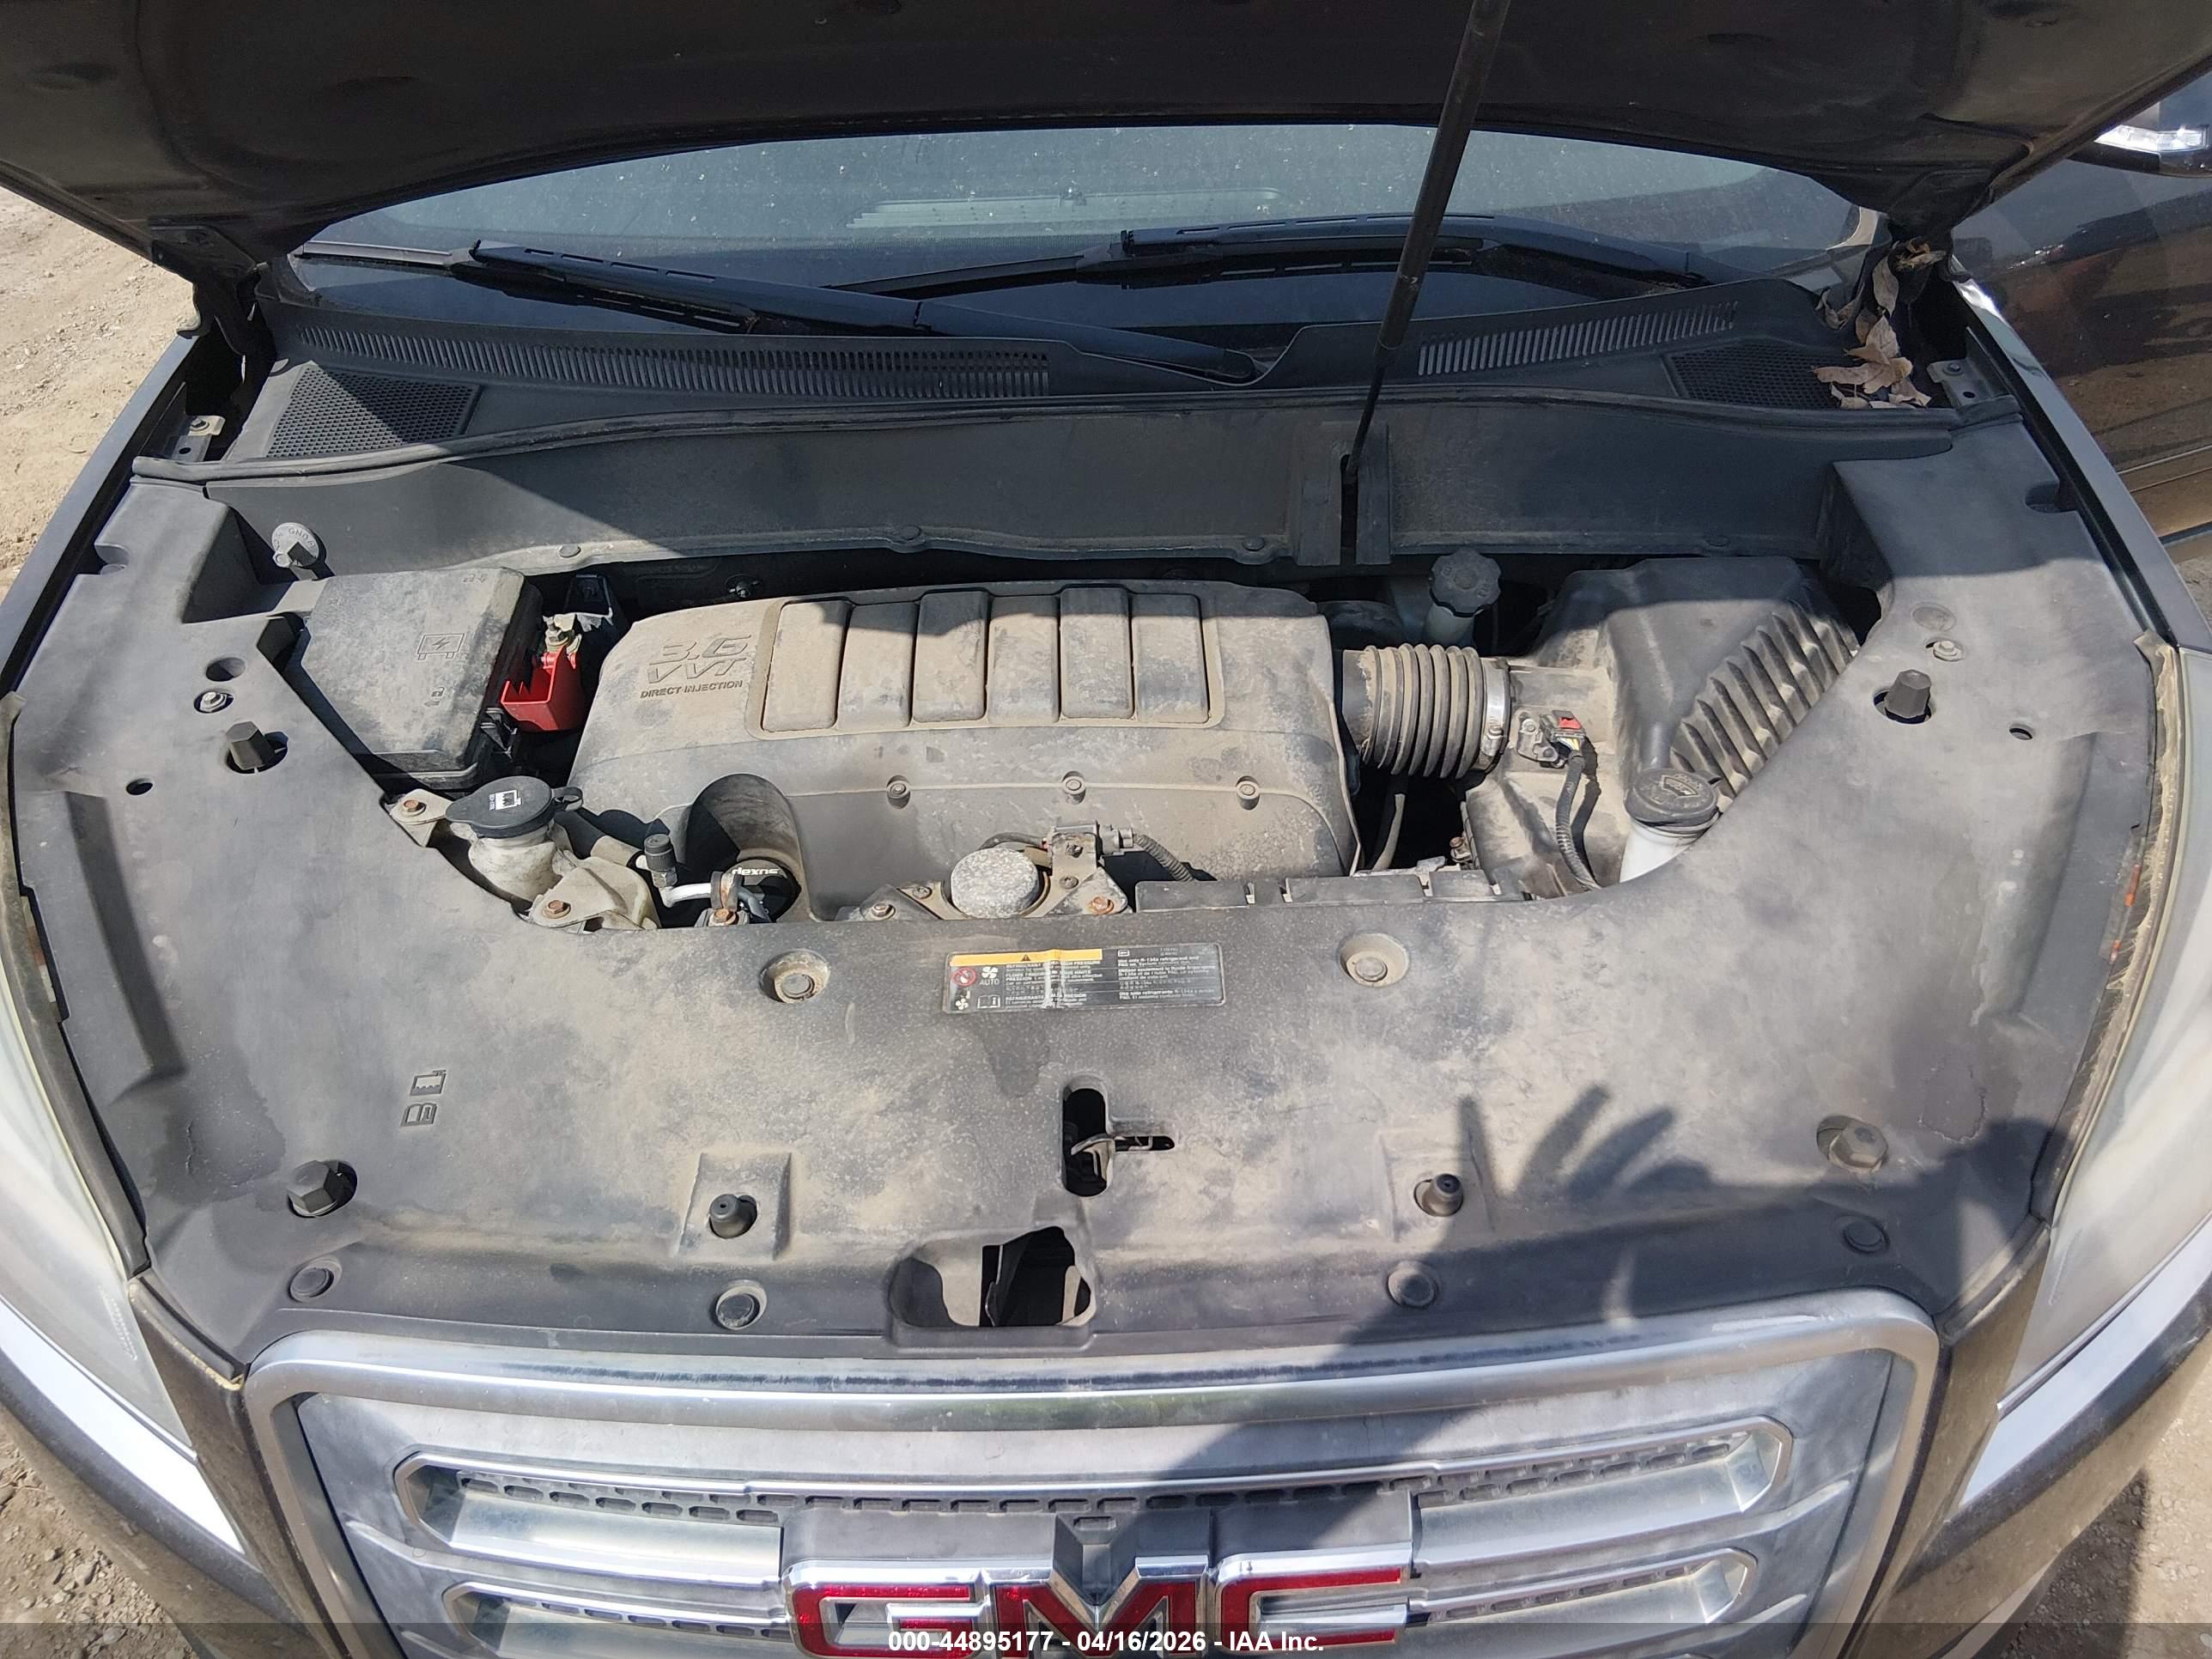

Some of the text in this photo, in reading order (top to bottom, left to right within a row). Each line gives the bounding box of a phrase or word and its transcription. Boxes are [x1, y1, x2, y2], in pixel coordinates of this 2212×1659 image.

[648, 634, 752, 666] 3.6
[647, 657, 747, 684] VVT
[640, 680, 744, 699] DIRECT INJECTION
[783, 1544, 1413, 1659] GMC
